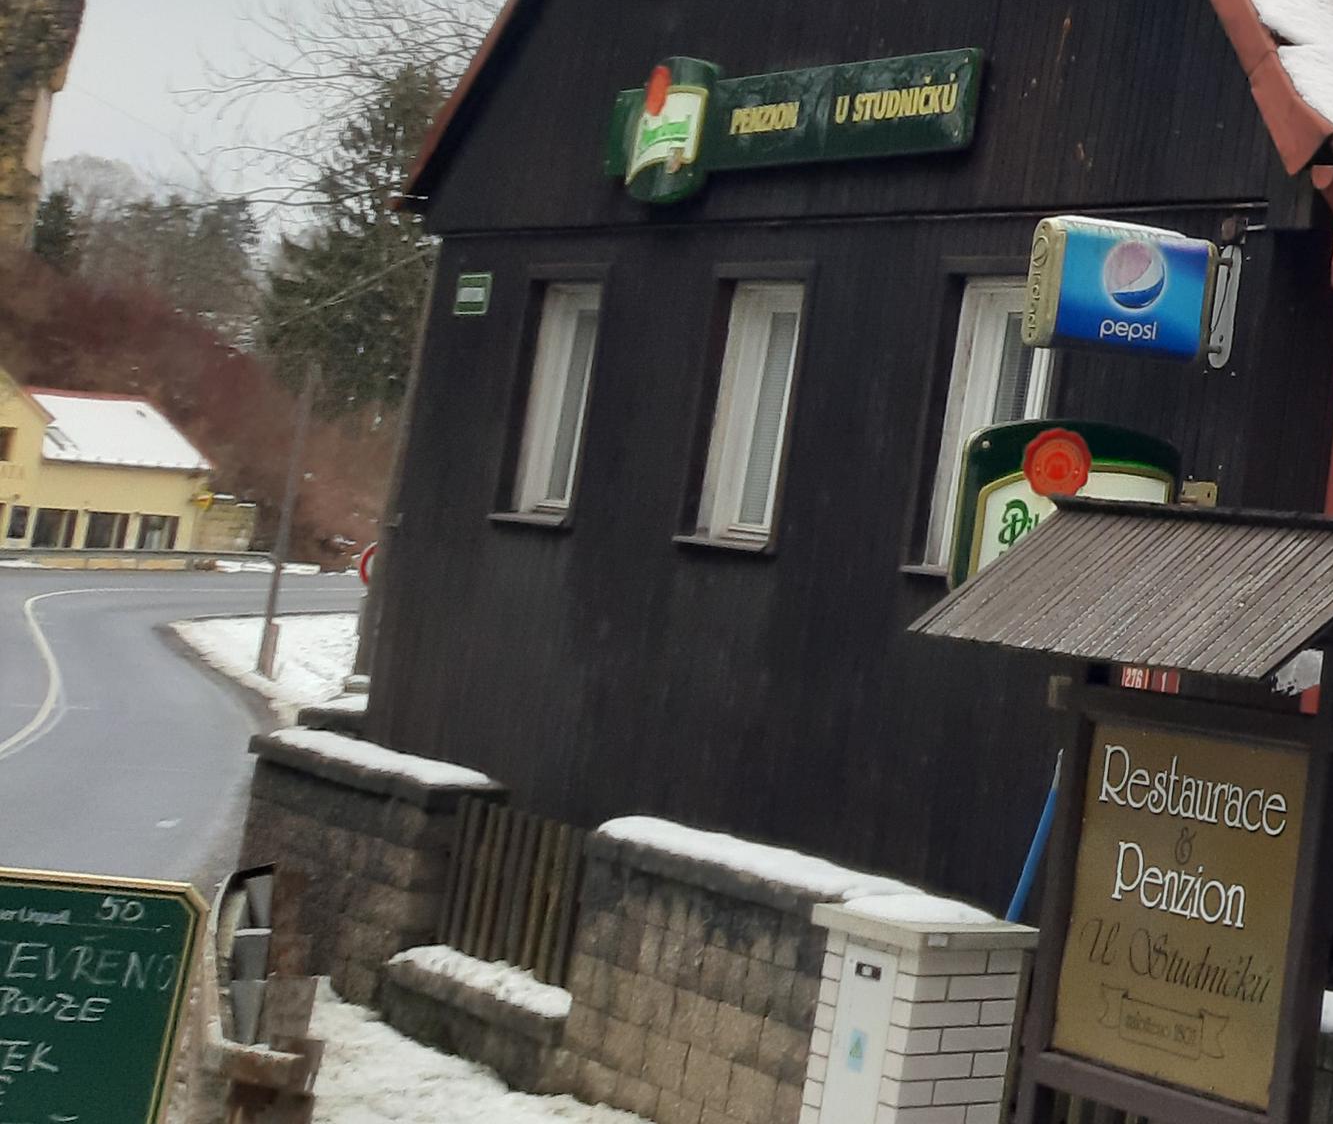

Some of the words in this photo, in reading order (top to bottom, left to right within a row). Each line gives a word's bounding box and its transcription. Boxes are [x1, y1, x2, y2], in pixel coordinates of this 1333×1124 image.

[729, 101, 800, 136] PENZION
[834, 95, 850, 125] U
[1099, 319, 1158, 342] pepsi
[1125, 666, 1144, 689] 276
[1098, 744, 1288, 837] Restaurace
[1111, 840, 1246, 929] Penzion
[101, 895, 145, 922] 50
